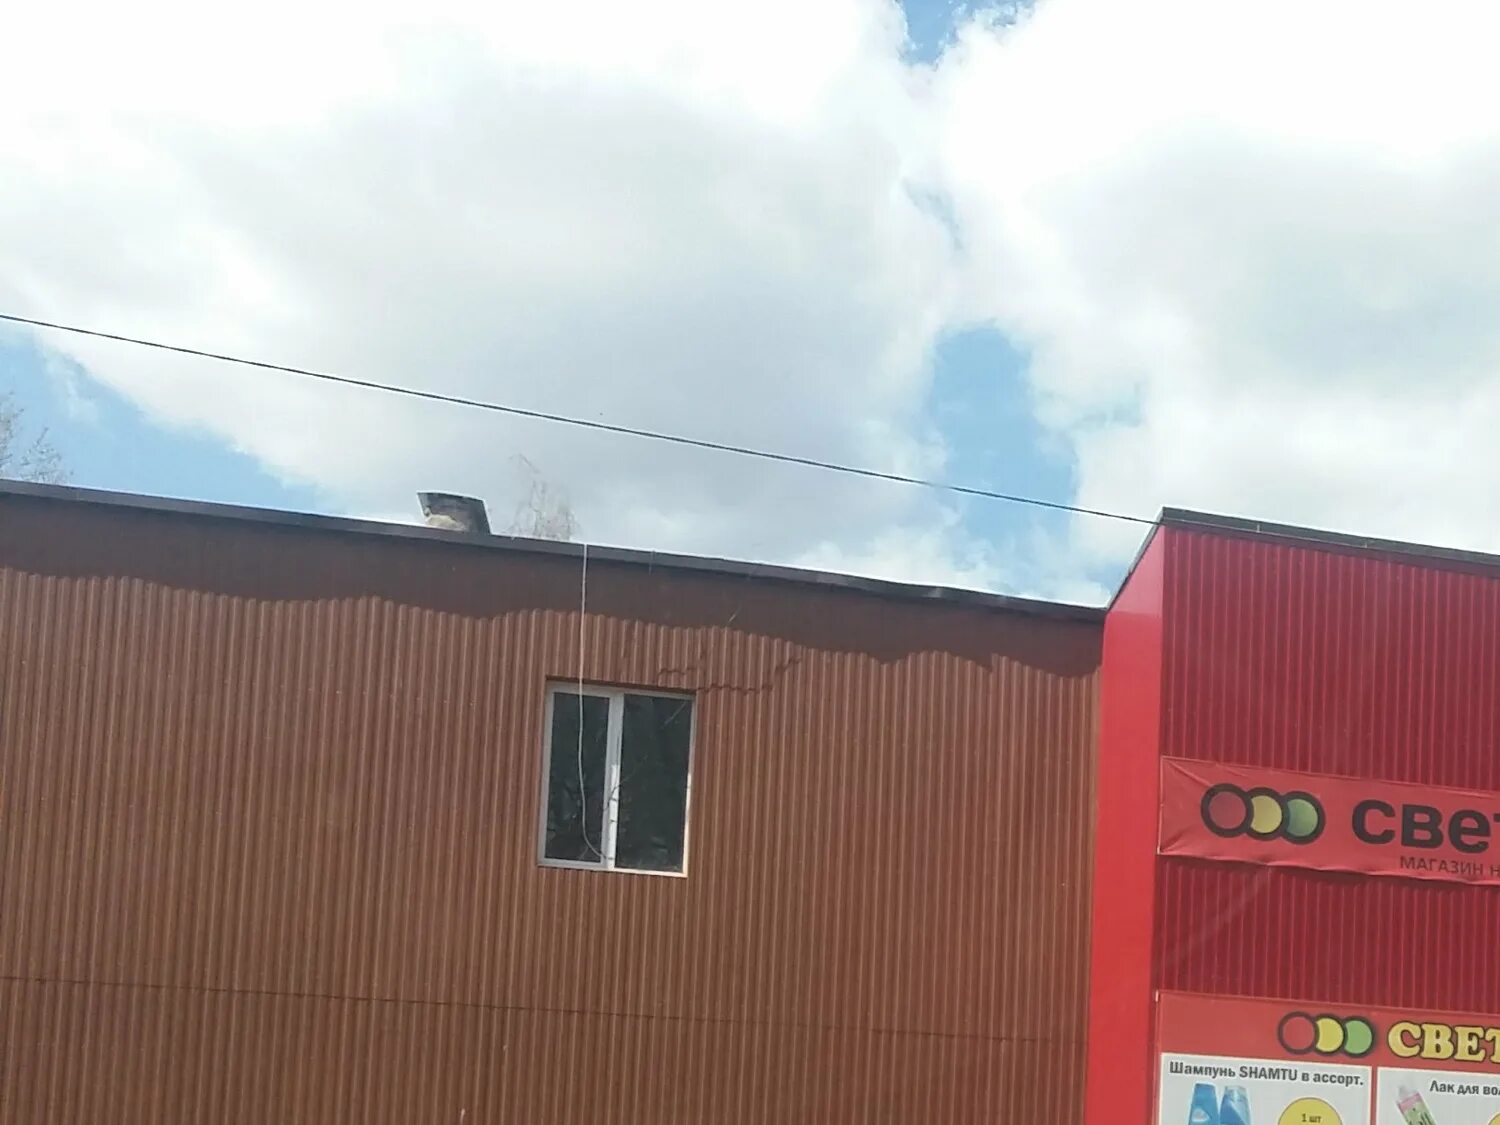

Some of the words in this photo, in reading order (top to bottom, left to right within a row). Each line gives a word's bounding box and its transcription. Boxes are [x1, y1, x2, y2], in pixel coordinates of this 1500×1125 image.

[1400, 854, 1484, 877] МАГАЗИН
[1169, 1061, 1236, 1078] Шампунь
[1239, 1065, 1298, 1081] SHAMTU
[1301, 1072, 1310, 1082] в
[1312, 1074, 1364, 1087] ассорт.
[1430, 1080, 1454, 1093] Лак
[1457, 1085, 1480, 1096] для
[1309, 1115, 1321, 1123] шт
